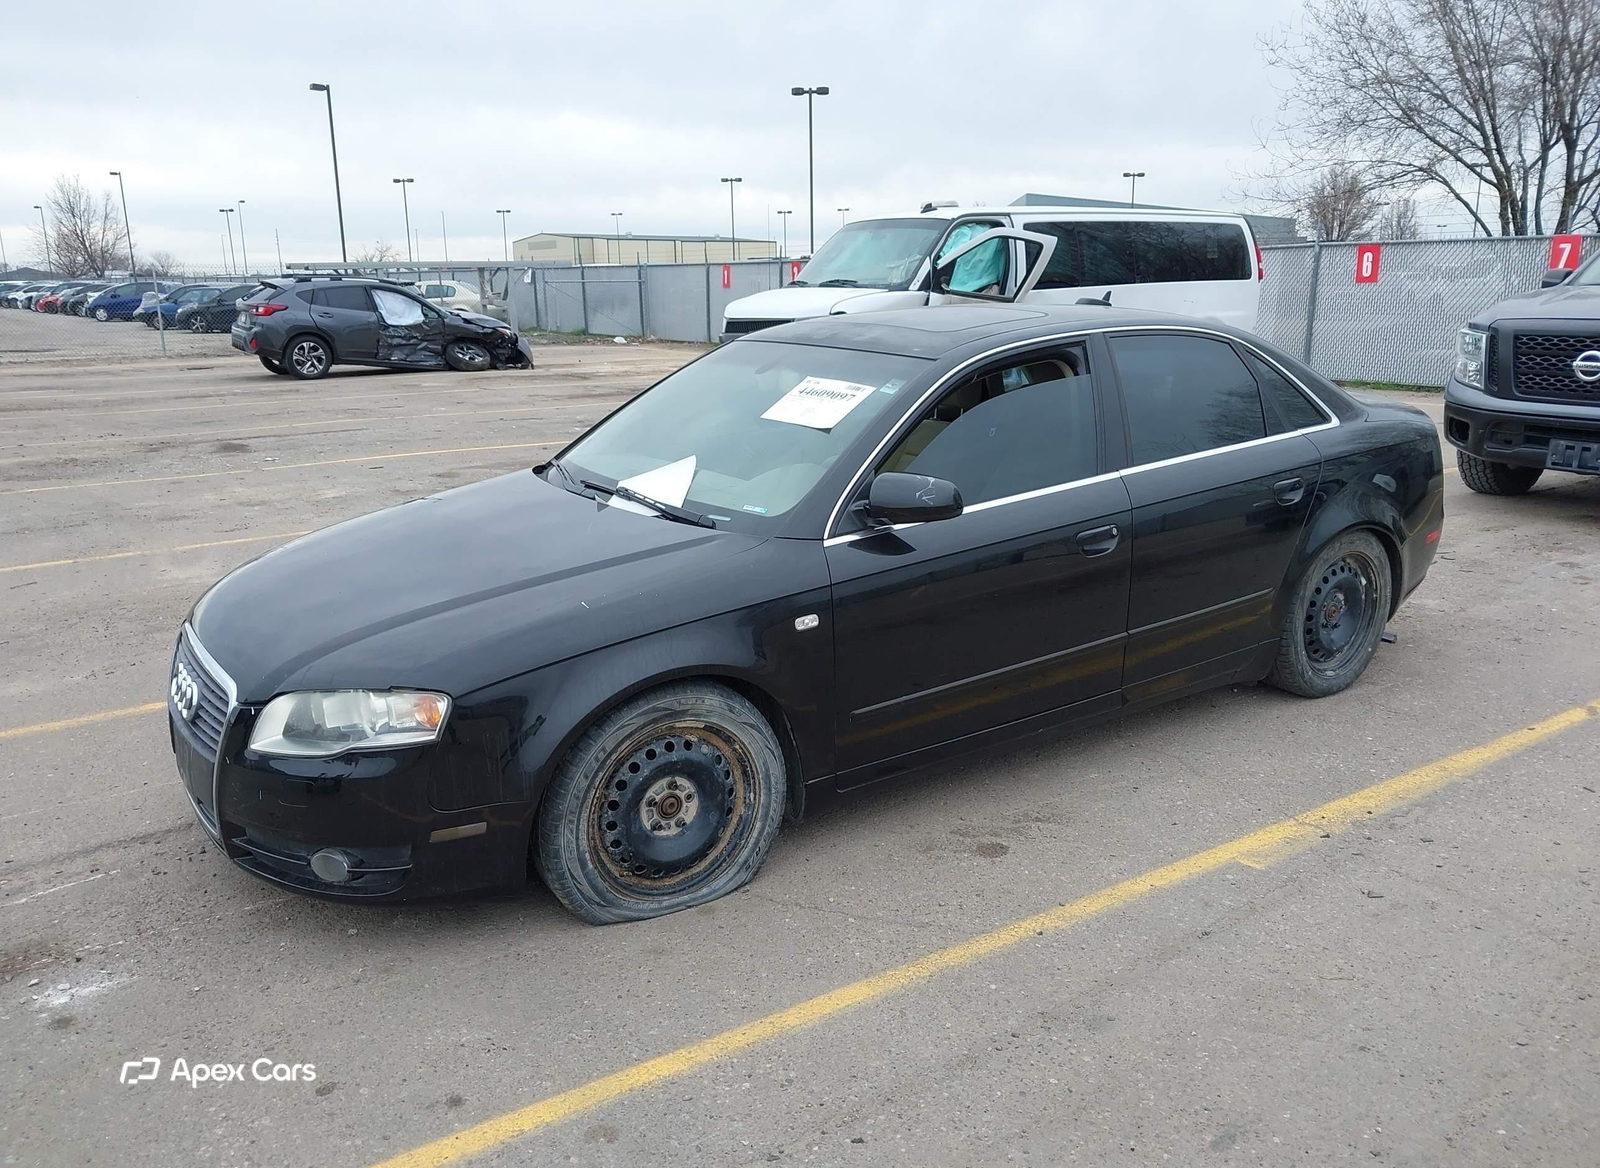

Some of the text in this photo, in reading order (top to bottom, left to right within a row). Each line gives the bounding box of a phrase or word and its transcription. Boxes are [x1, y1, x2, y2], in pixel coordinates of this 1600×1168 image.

[1361, 251, 1374, 278] 6
[1557, 242, 1572, 269] 7
[724, 269, 729, 285] 1
[798, 387, 857, 402] 44609097
